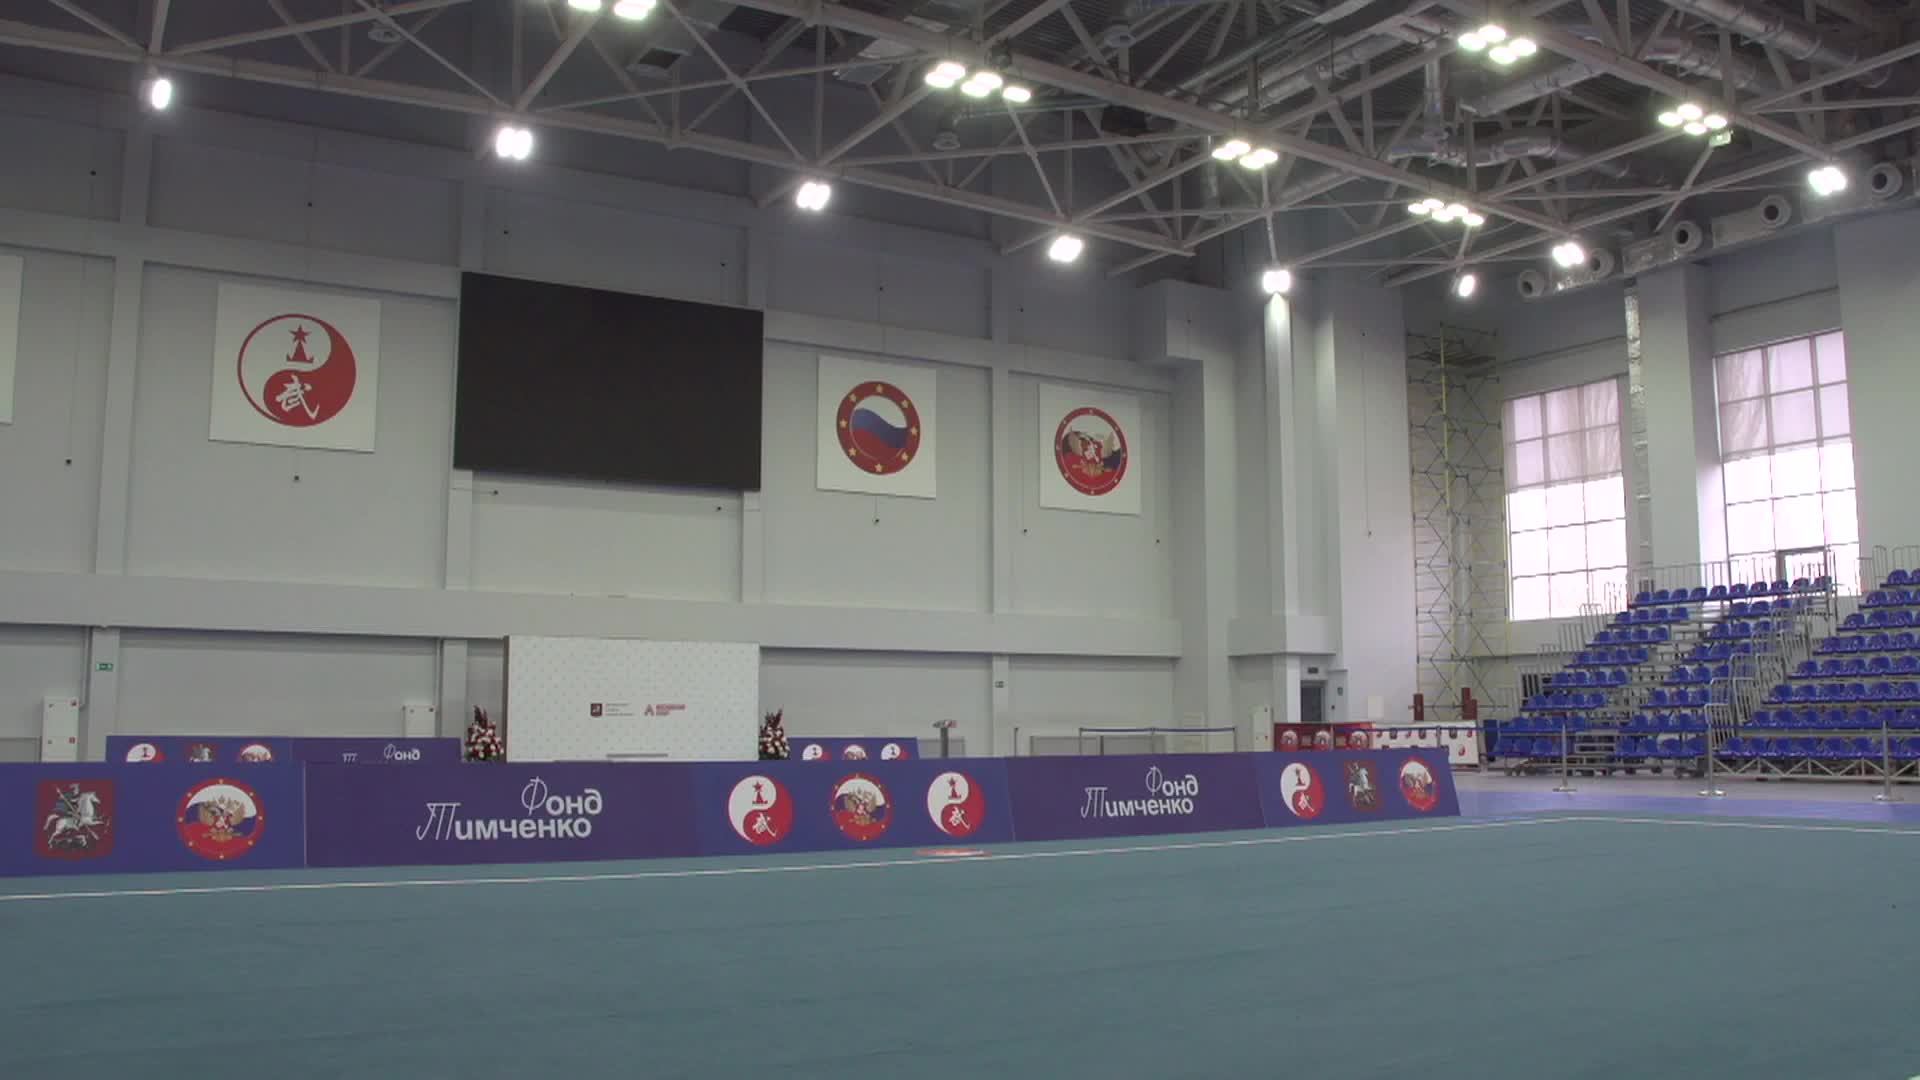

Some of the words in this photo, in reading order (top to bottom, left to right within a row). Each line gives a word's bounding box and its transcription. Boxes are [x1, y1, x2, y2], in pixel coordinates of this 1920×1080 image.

[275, 374, 320, 420] 武
[384, 744, 420, 761] Фонд
[521, 776, 603, 816] Фонд
[1145, 766, 1199, 797] Фонд
[1080, 787, 1194, 818] Тимченко
[416, 802, 592, 840] Тимченко
